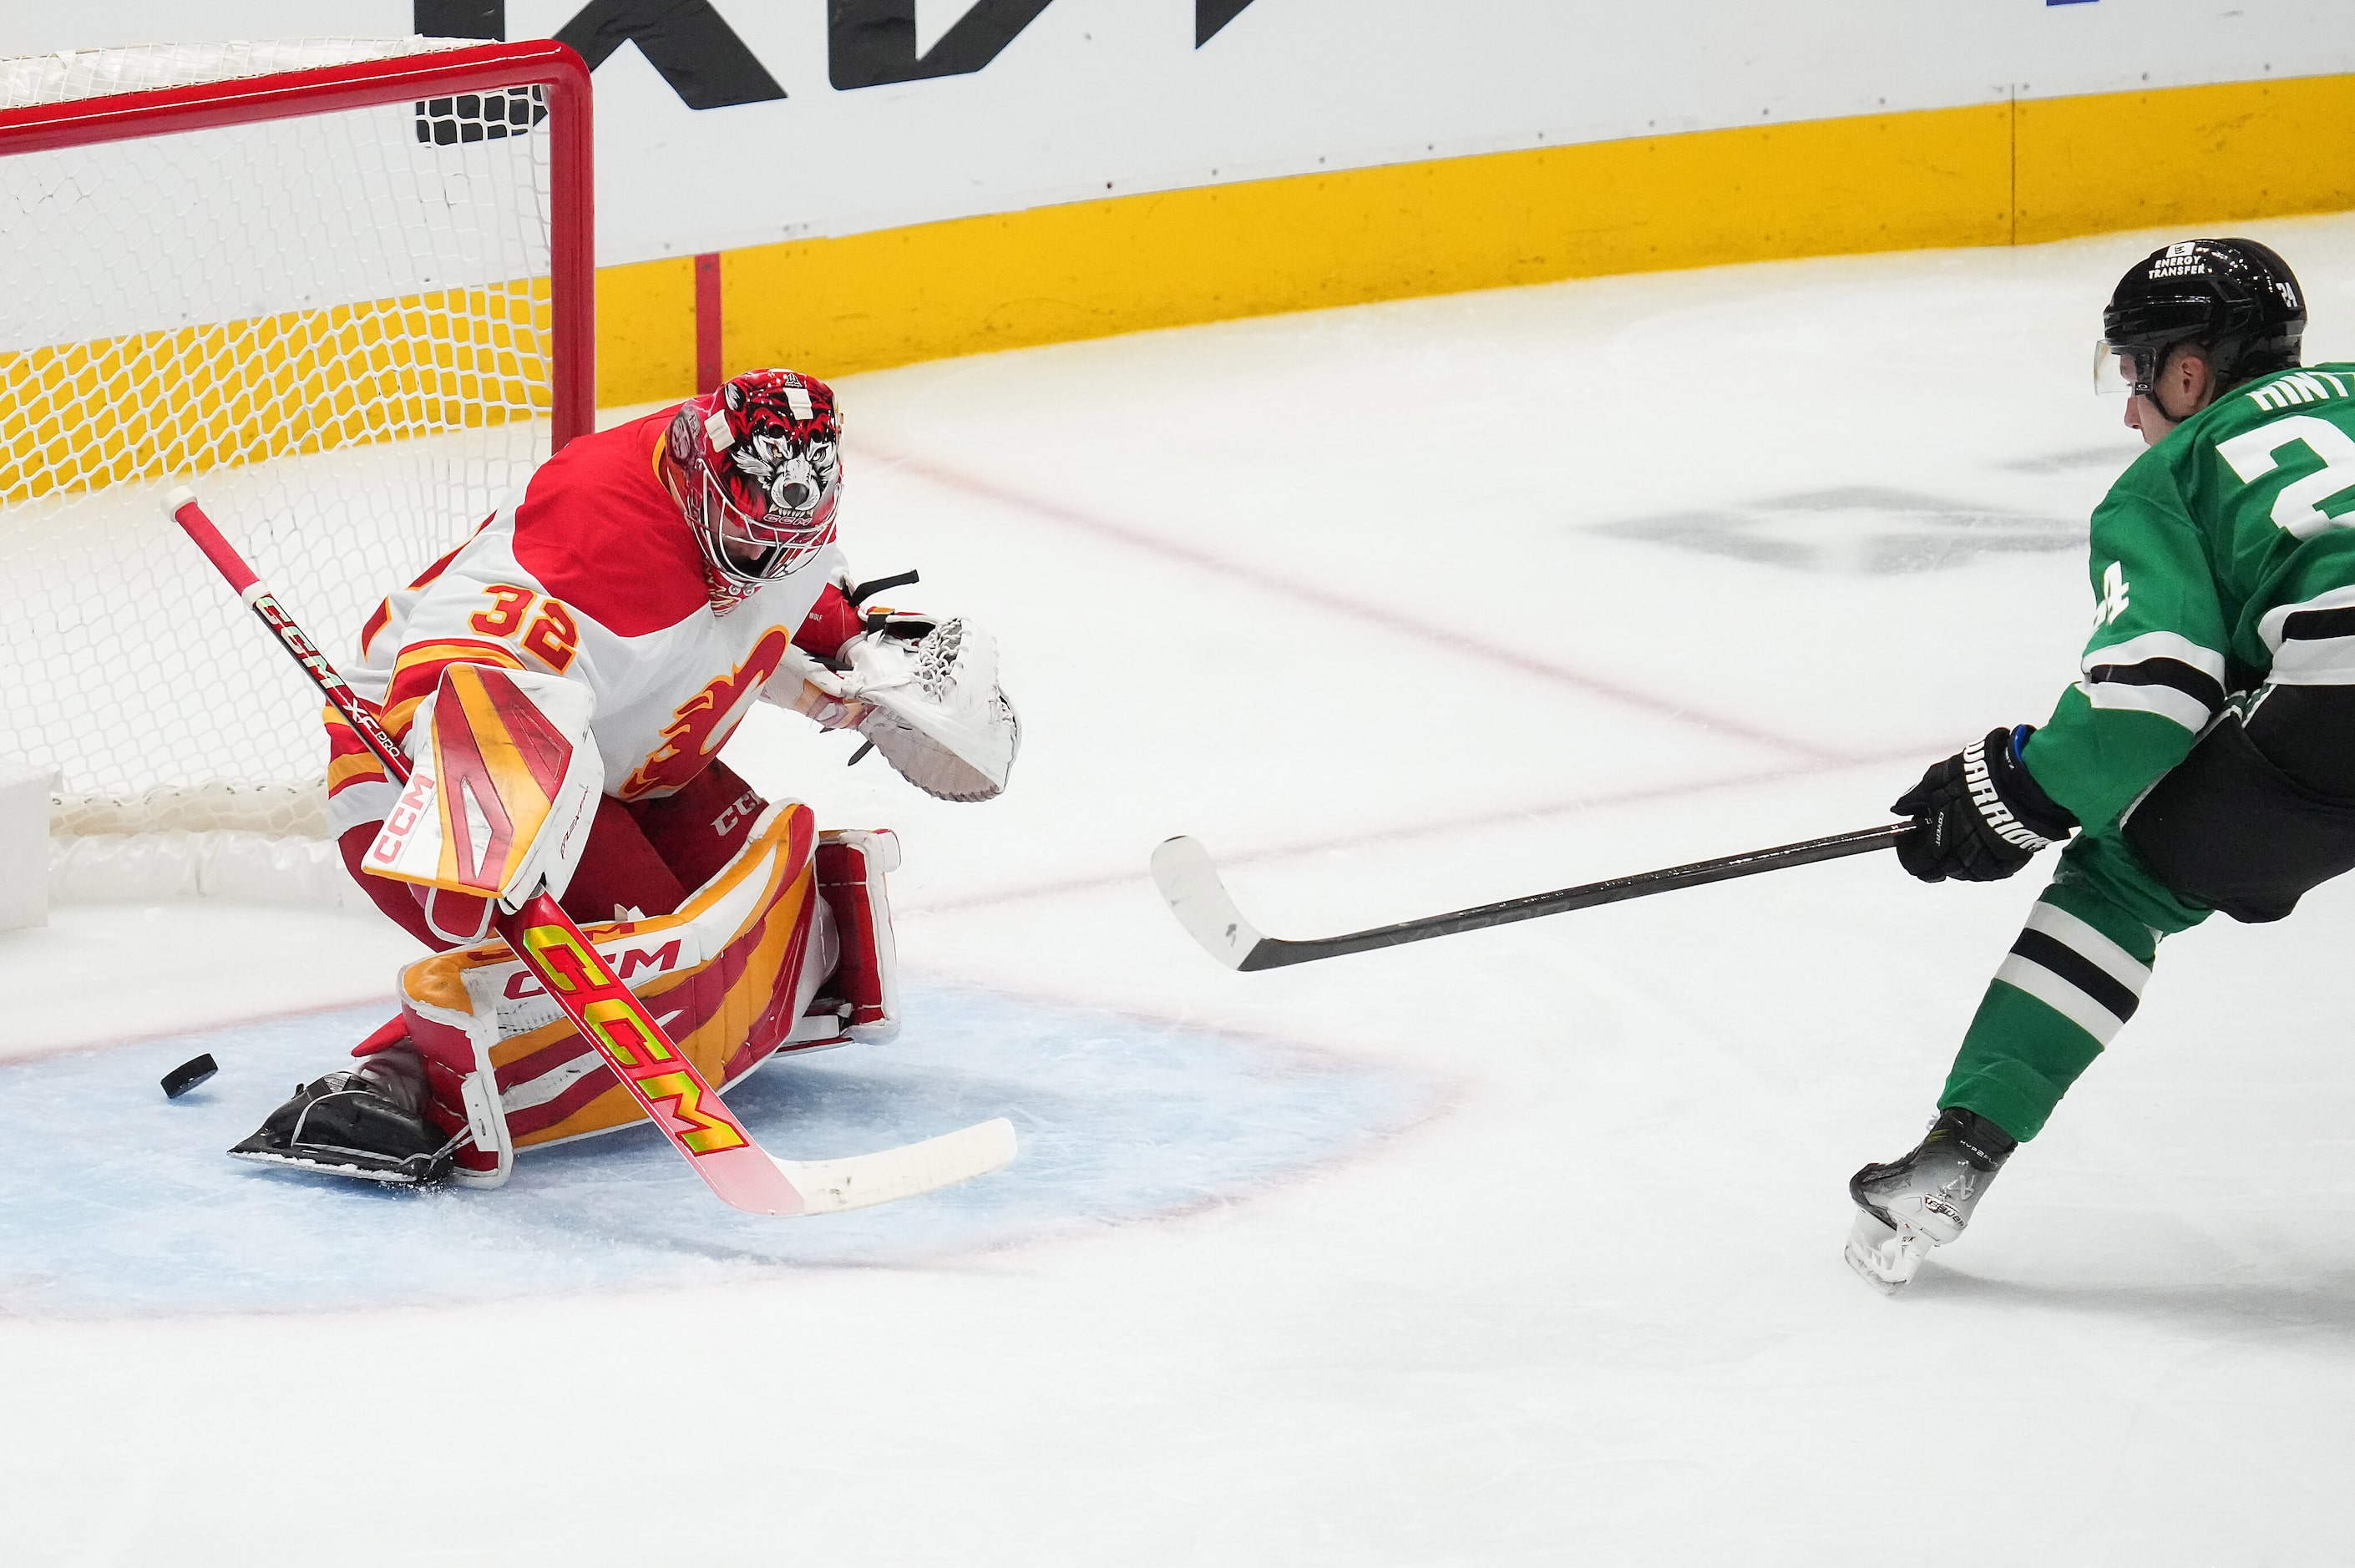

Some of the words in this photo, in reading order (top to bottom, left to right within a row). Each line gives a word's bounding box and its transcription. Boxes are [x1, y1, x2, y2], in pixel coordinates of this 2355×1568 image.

[2148, 265, 2206, 280] TRANSFER
[2155, 255, 2201, 269] ENERGY
[2276, 281, 2298, 308] 24
[763, 513, 813, 526] CCM
[256, 596, 347, 690] CCM
[467, 583, 580, 675] 32
[372, 772, 436, 865] CCM
[1935, 811, 1945, 847] COVERT
[521, 923, 750, 1156] CCM
